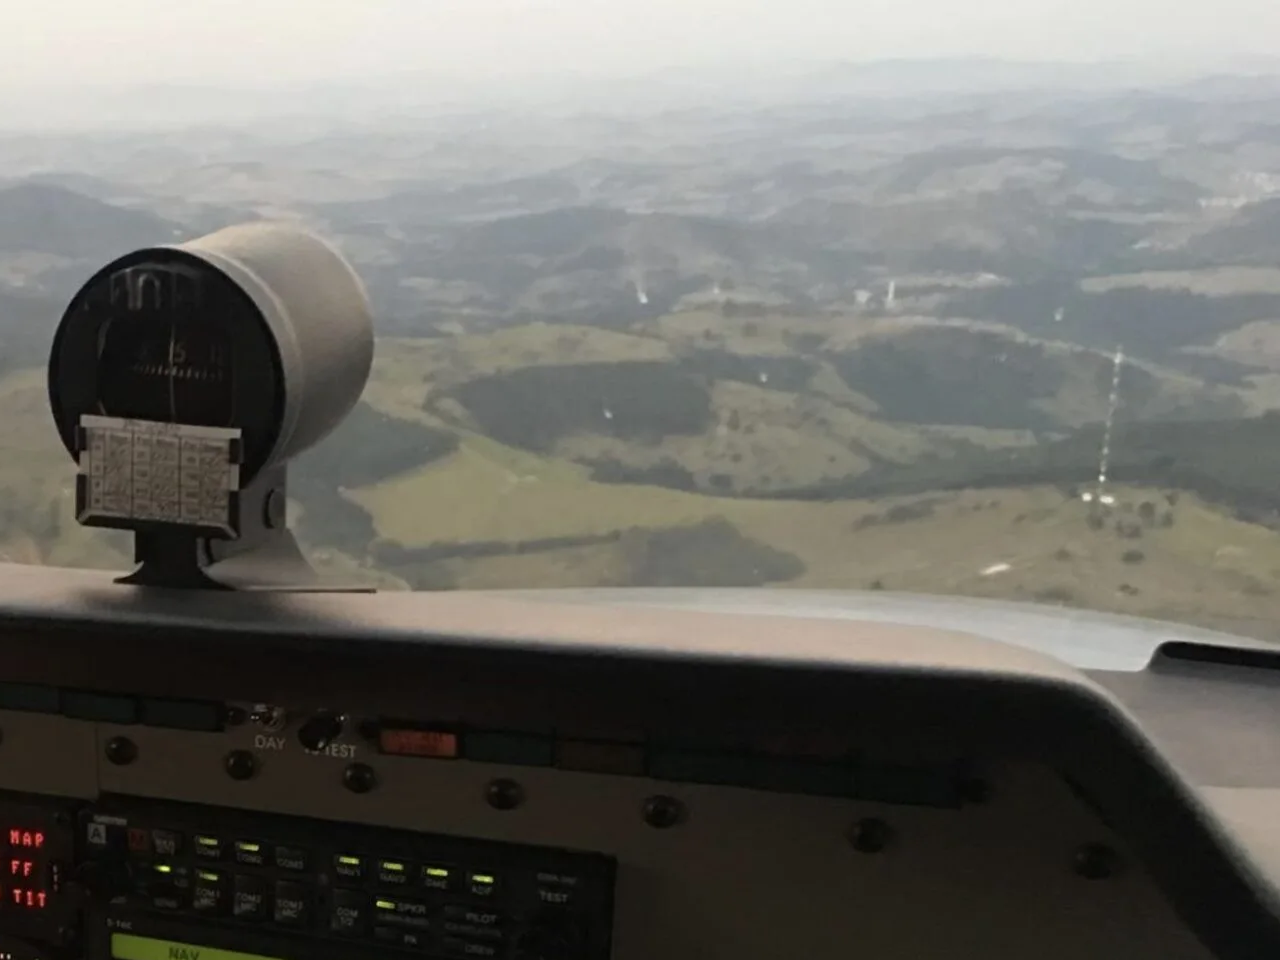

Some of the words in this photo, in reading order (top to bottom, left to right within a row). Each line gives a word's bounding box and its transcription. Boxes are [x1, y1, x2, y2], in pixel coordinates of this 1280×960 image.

[254, 734, 286, 749] DAY
[10, 829, 45, 848] MAP
[11, 860, 33, 878] FF
[13, 889, 46, 908] TIT
